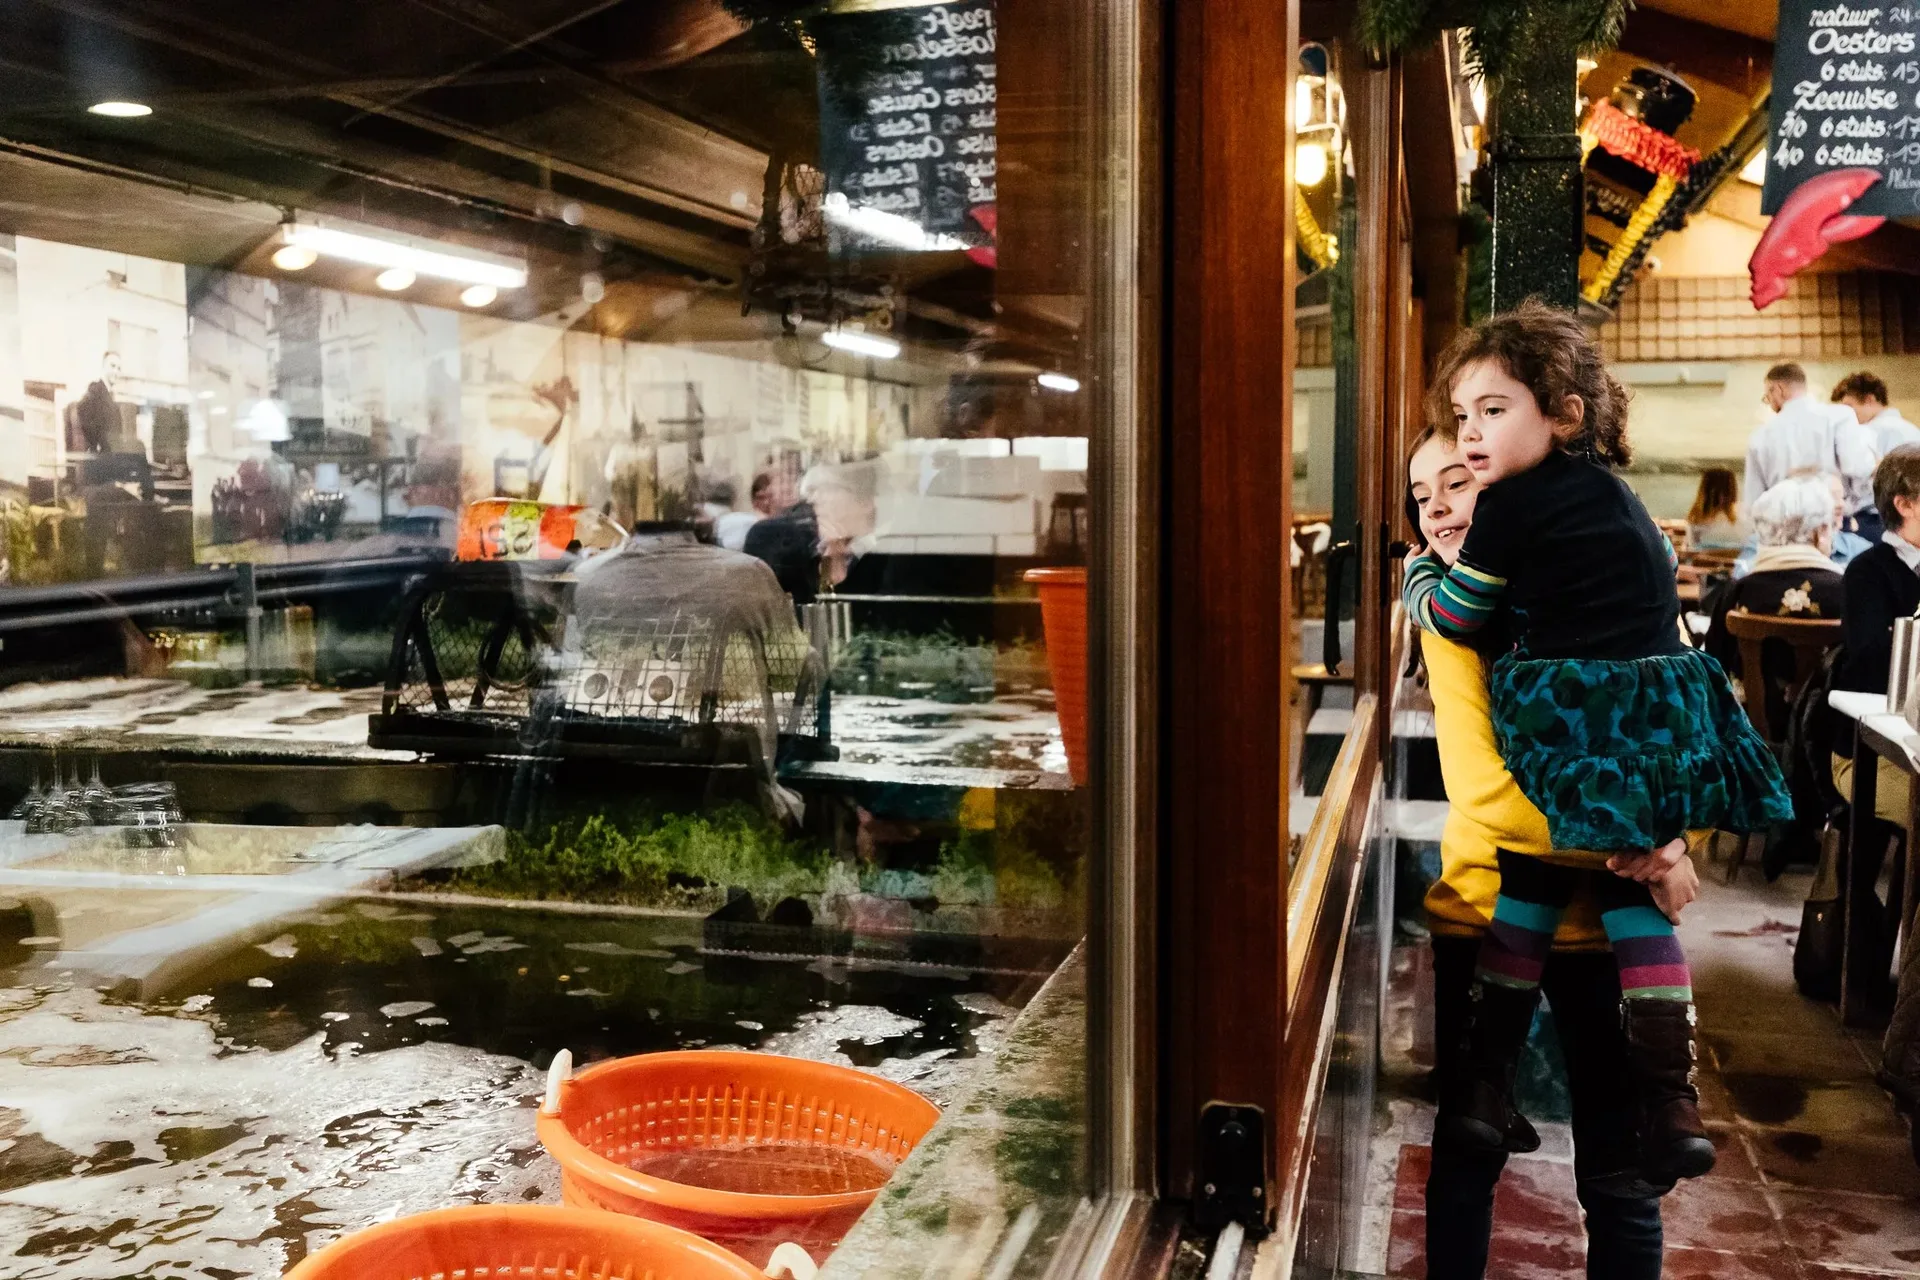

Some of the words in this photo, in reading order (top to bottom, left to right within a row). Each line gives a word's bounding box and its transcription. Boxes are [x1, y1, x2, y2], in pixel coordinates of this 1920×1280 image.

[1808, 27, 1916, 55] Oesters
[1820, 58, 1836, 82] 6
[1819, 116, 1835, 138] 6
[1814, 143, 1830, 166] 6
